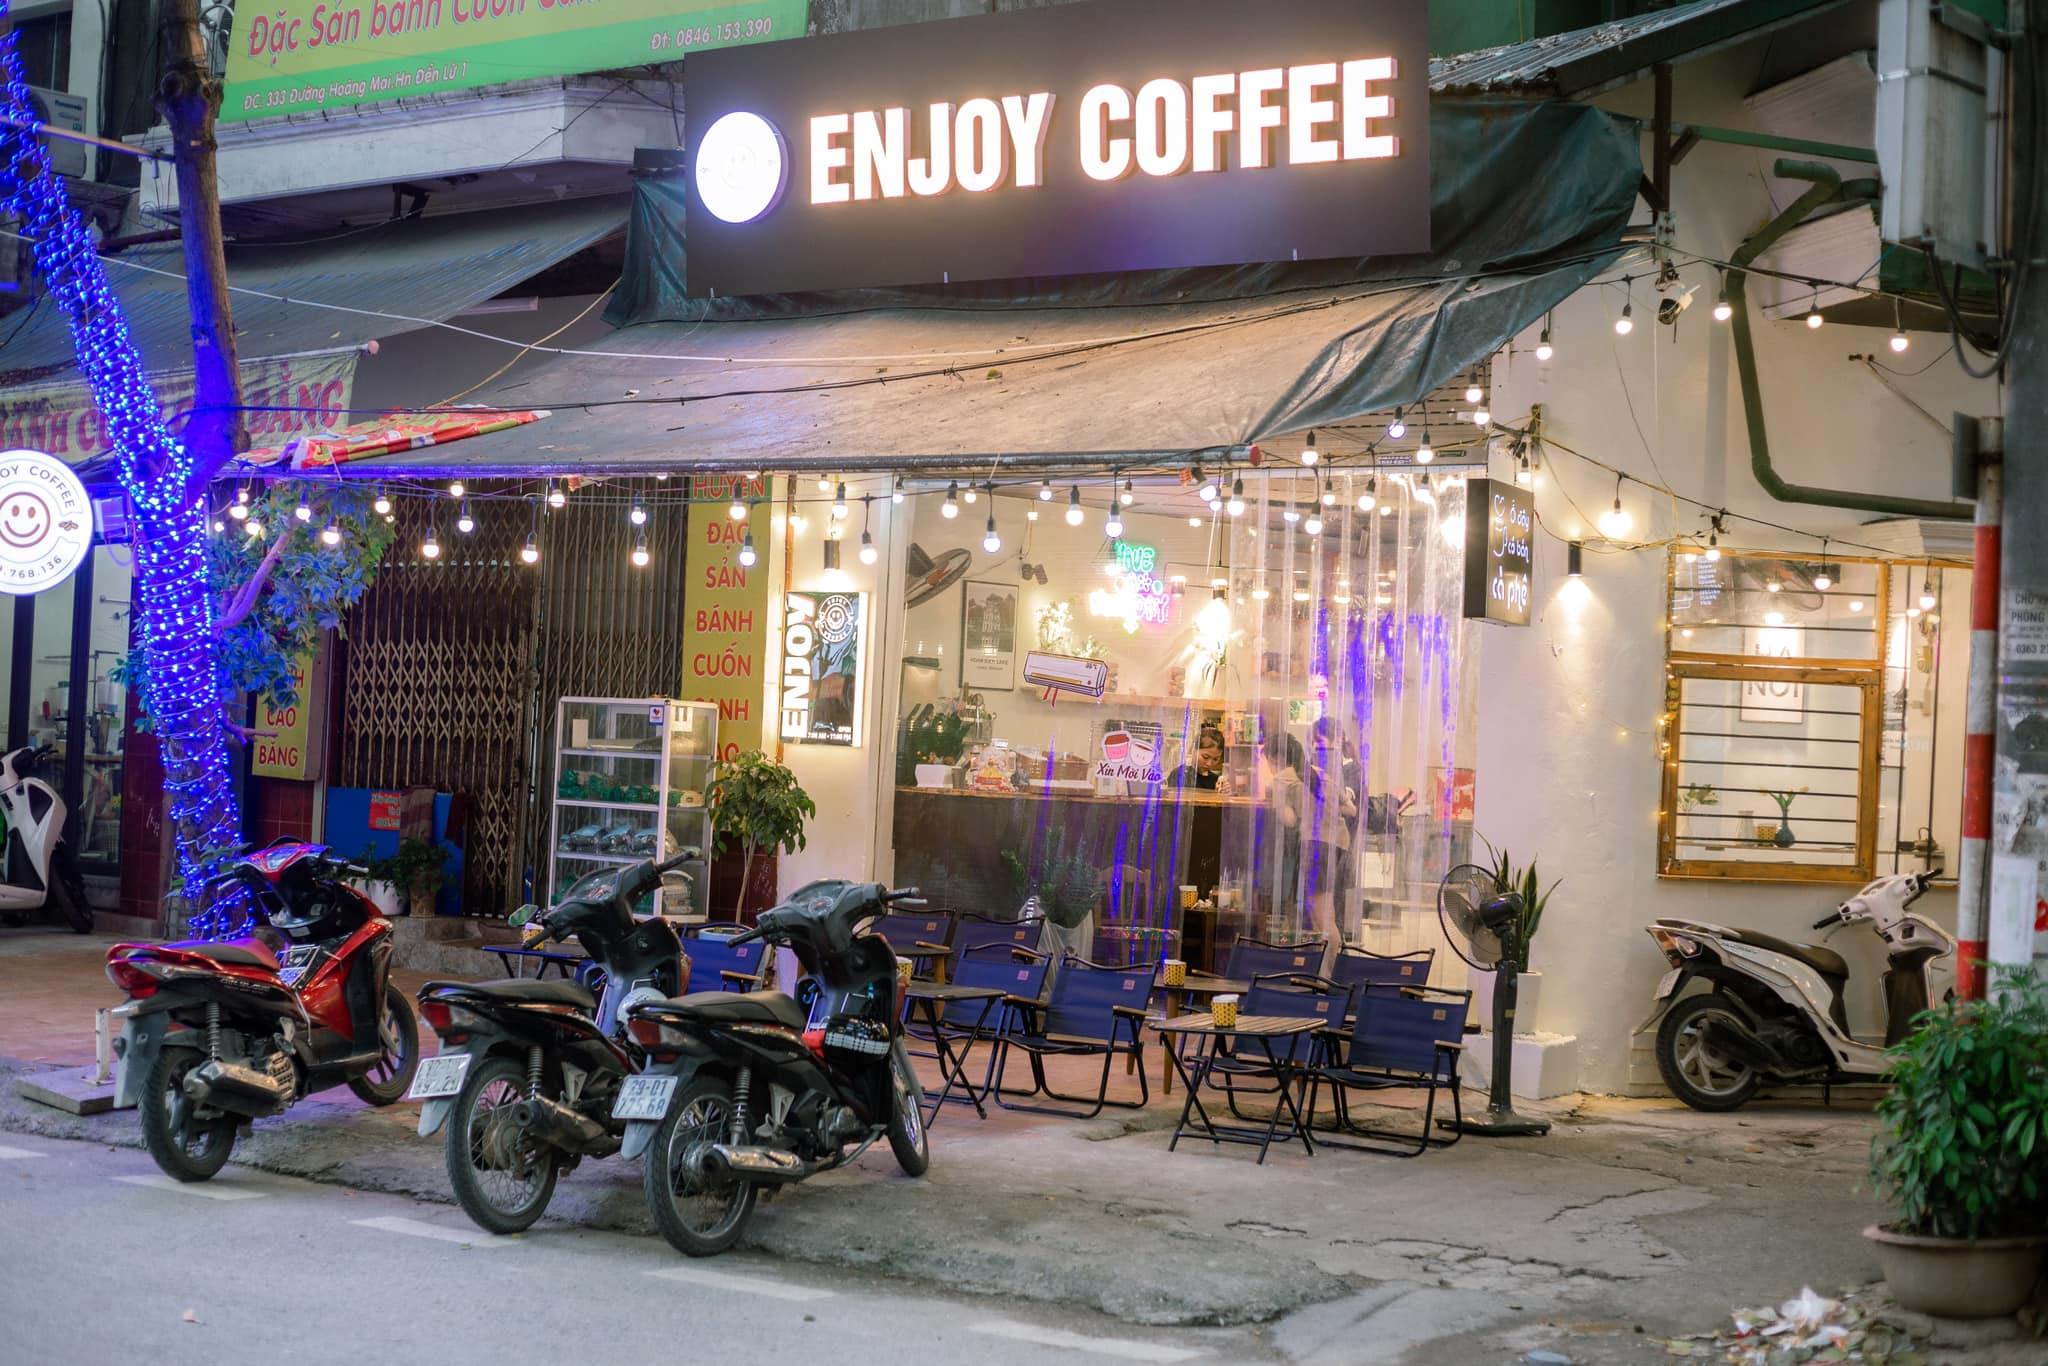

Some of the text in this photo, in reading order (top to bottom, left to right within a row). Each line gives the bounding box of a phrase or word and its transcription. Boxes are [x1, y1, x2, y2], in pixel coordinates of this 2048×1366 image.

[249, 9, 301, 66] Đặc
[676, 17, 772, 47] 0846.153.390
[266, 89, 286, 107] 333
[809, 56, 1401, 205] ENJOY COFFEE
[29, 465, 76, 509] COFFEE
[705, 556, 746, 589] SẢN
[1507, 573, 1528, 613] phê
[695, 603, 753, 633] BÁNH
[693, 641, 752, 677] CUỐN
[781, 592, 814, 738] ENJOY
[1097, 762, 1114, 777] Xin
